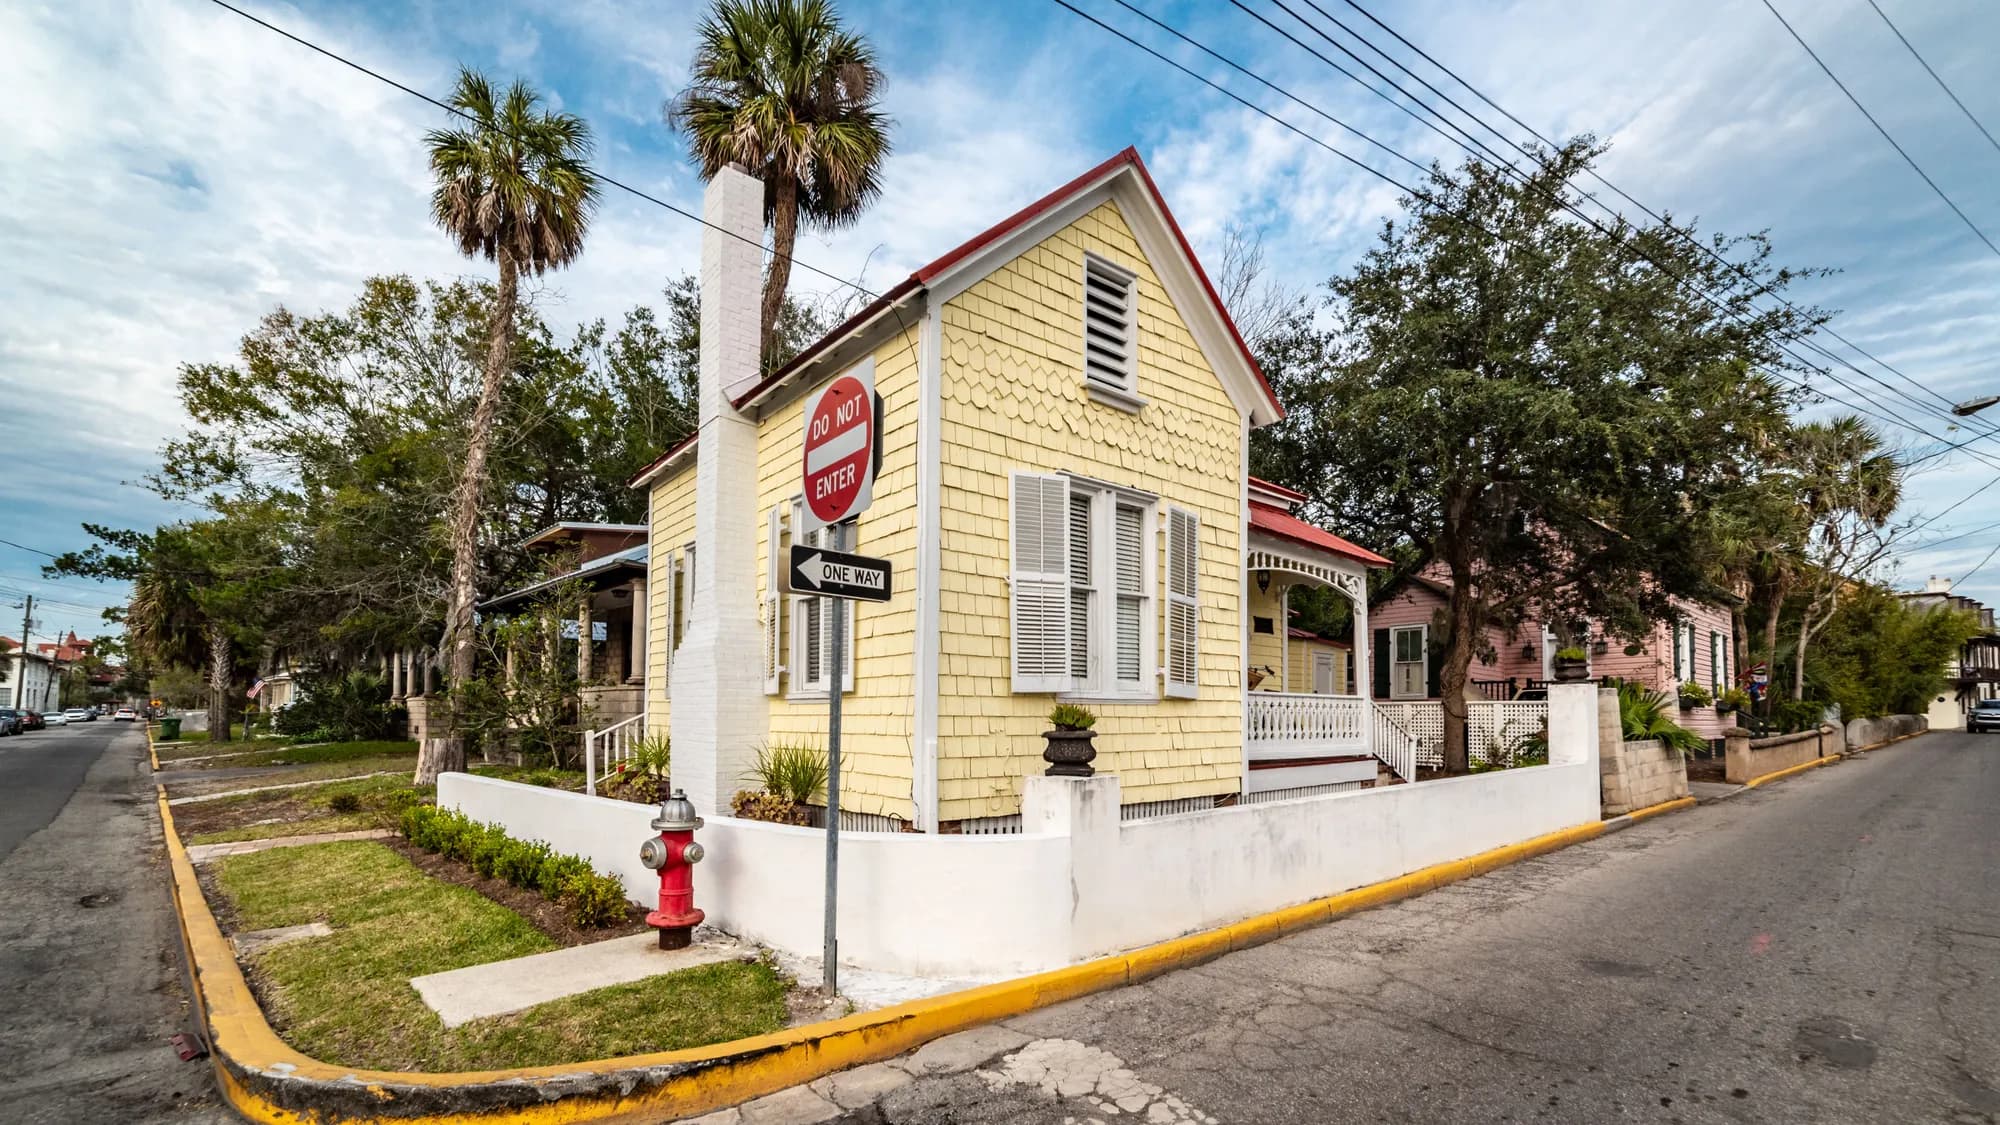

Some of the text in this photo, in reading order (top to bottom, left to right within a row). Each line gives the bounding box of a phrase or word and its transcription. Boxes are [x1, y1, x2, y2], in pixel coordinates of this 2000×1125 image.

[813, 394, 862, 440] DO NOT
[816, 463, 855, 500] ENTER
[823, 564, 881, 587] ONE WAY
